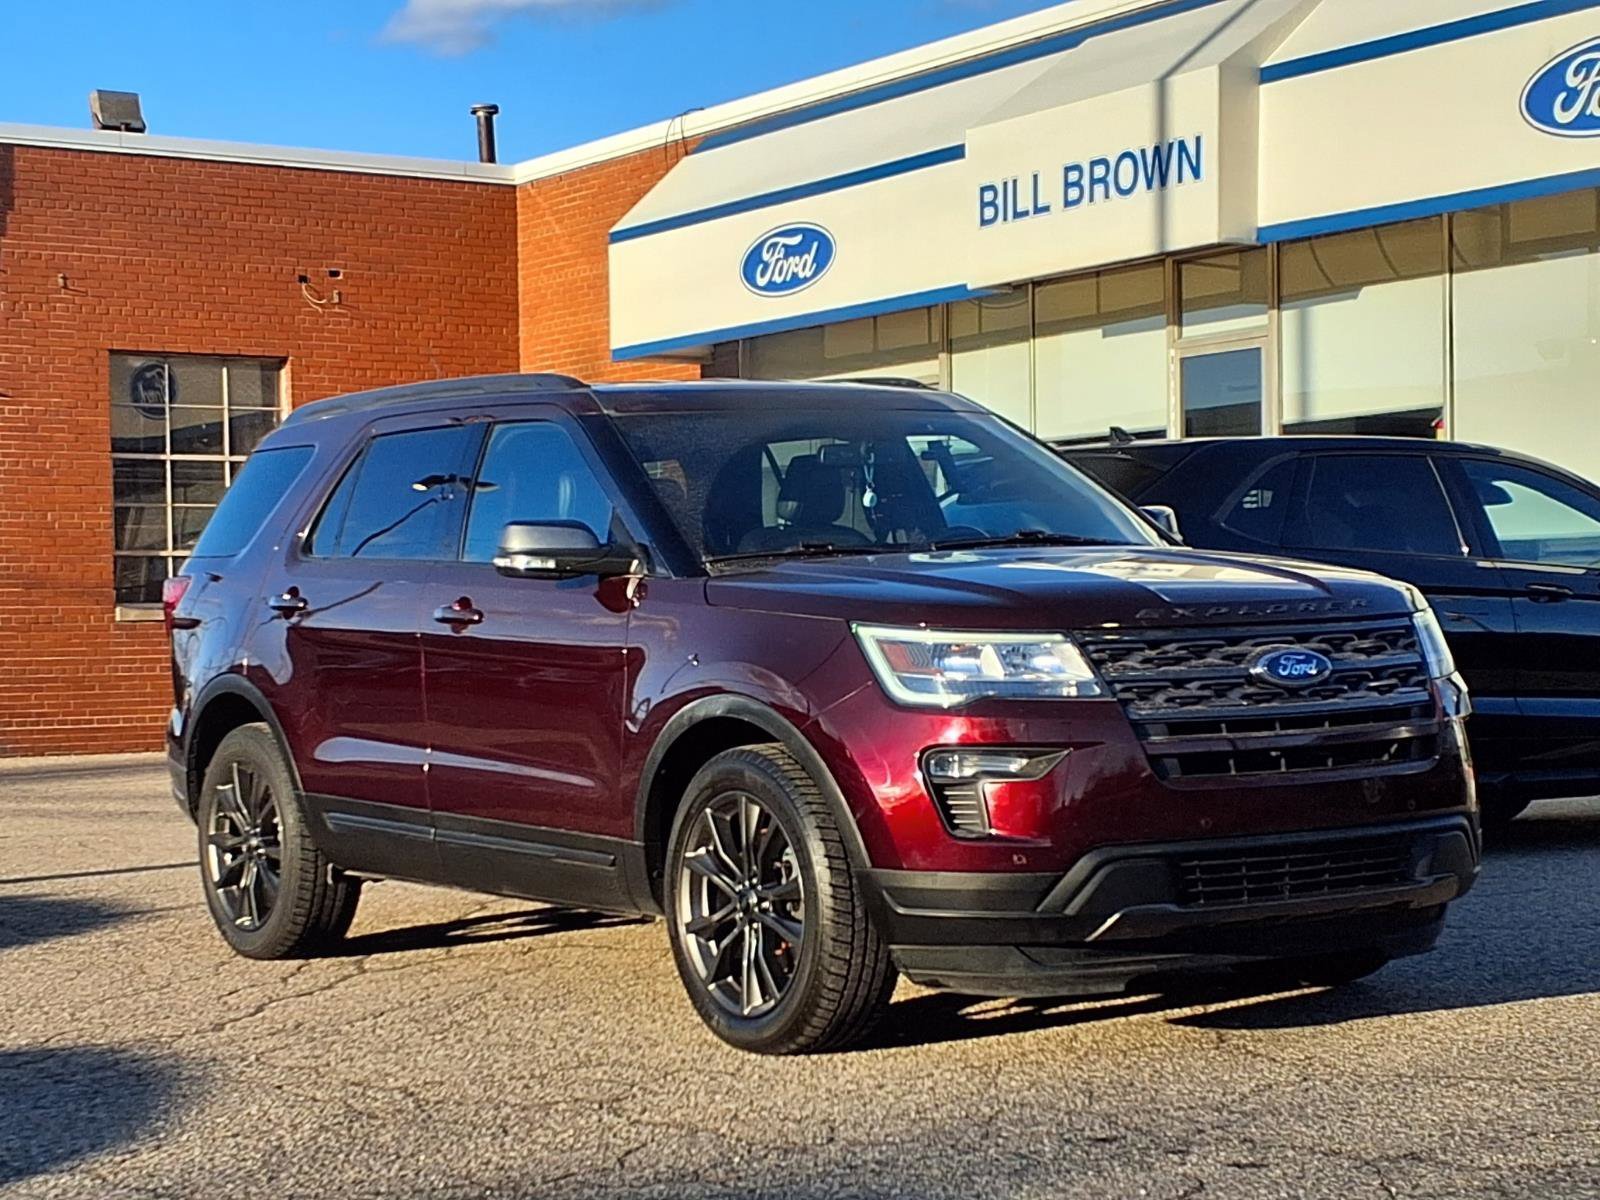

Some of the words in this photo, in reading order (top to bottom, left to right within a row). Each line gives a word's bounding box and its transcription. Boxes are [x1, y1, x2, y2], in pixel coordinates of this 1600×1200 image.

[979, 173, 1050, 227] BILL
[1062, 135, 1202, 209] BROWN
[755, 233, 819, 287] Ford
[1135, 598, 1367, 619] EXPLORER
[1278, 654, 1318, 676] Ford
